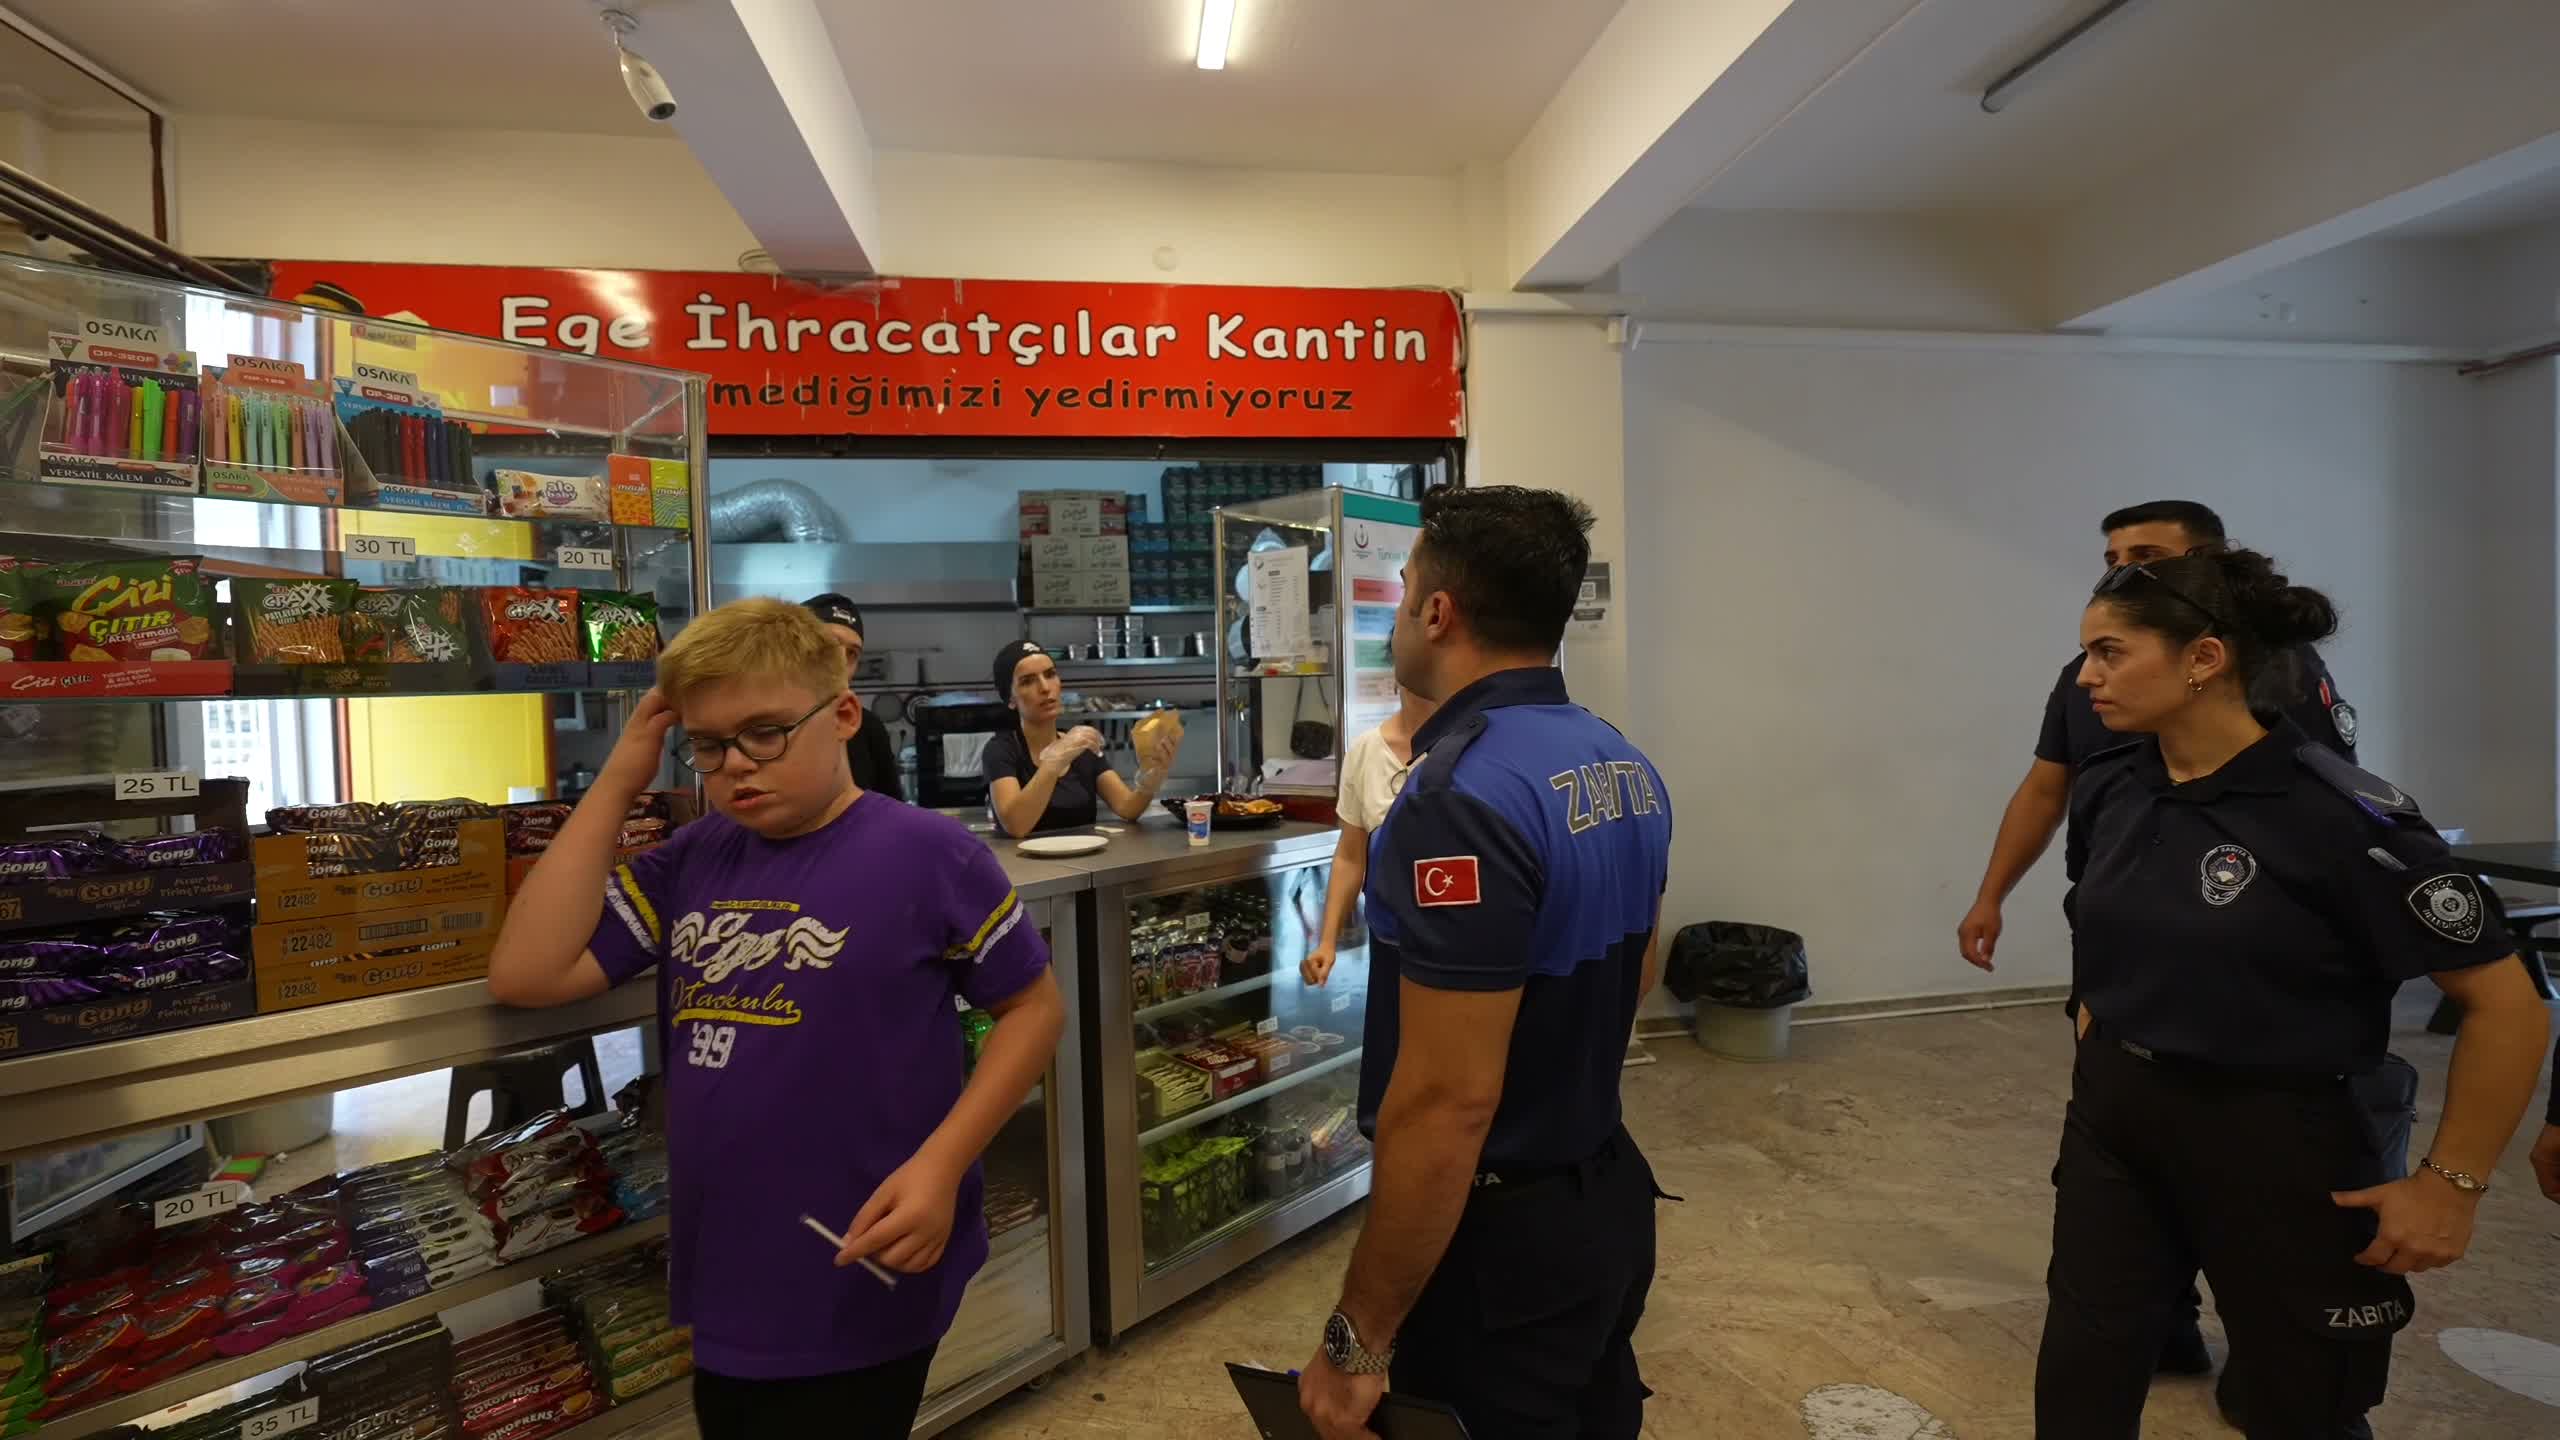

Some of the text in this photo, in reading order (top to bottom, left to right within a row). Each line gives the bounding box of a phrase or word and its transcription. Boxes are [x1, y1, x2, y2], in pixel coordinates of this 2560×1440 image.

[86, 321, 158, 343] OSAKA
[501, 293, 1427, 365] Ege İhracatçılar Kantin
[234, 357, 296, 373] OSAKA
[357, 366, 411, 385] OSAKA
[1025, 378, 1353, 417] yedirmiyoruz
[47, 454, 98, 466] OSAKA
[105, 471, 144, 483] KALEM
[212, 471, 251, 482] OSAKA
[383, 485, 418, 495] OSAKA
[355, 539, 413, 556] 30 TL
[563, 551, 610, 566] 20 TL
[123, 776, 196, 794] 25 TL
[307, 807, 348, 820] Gong
[424, 837, 459, 849] Gong
[526, 836, 552, 847] Gon
[148, 847, 196, 863] Gong
[2423, 880, 2453, 897] BUCA
[153, 932, 199, 952] Gong
[0, 956, 37, 969] ong
[134, 970, 177, 989] Gong
[164, 1191, 233, 1219] 20 TL
[2324, 1300, 2408, 1328] ZABITA
[250, 1415, 279, 1437] 35
[287, 1406, 315, 1424] TL
[487, 1409, 554, 1440] OKOPRENS
